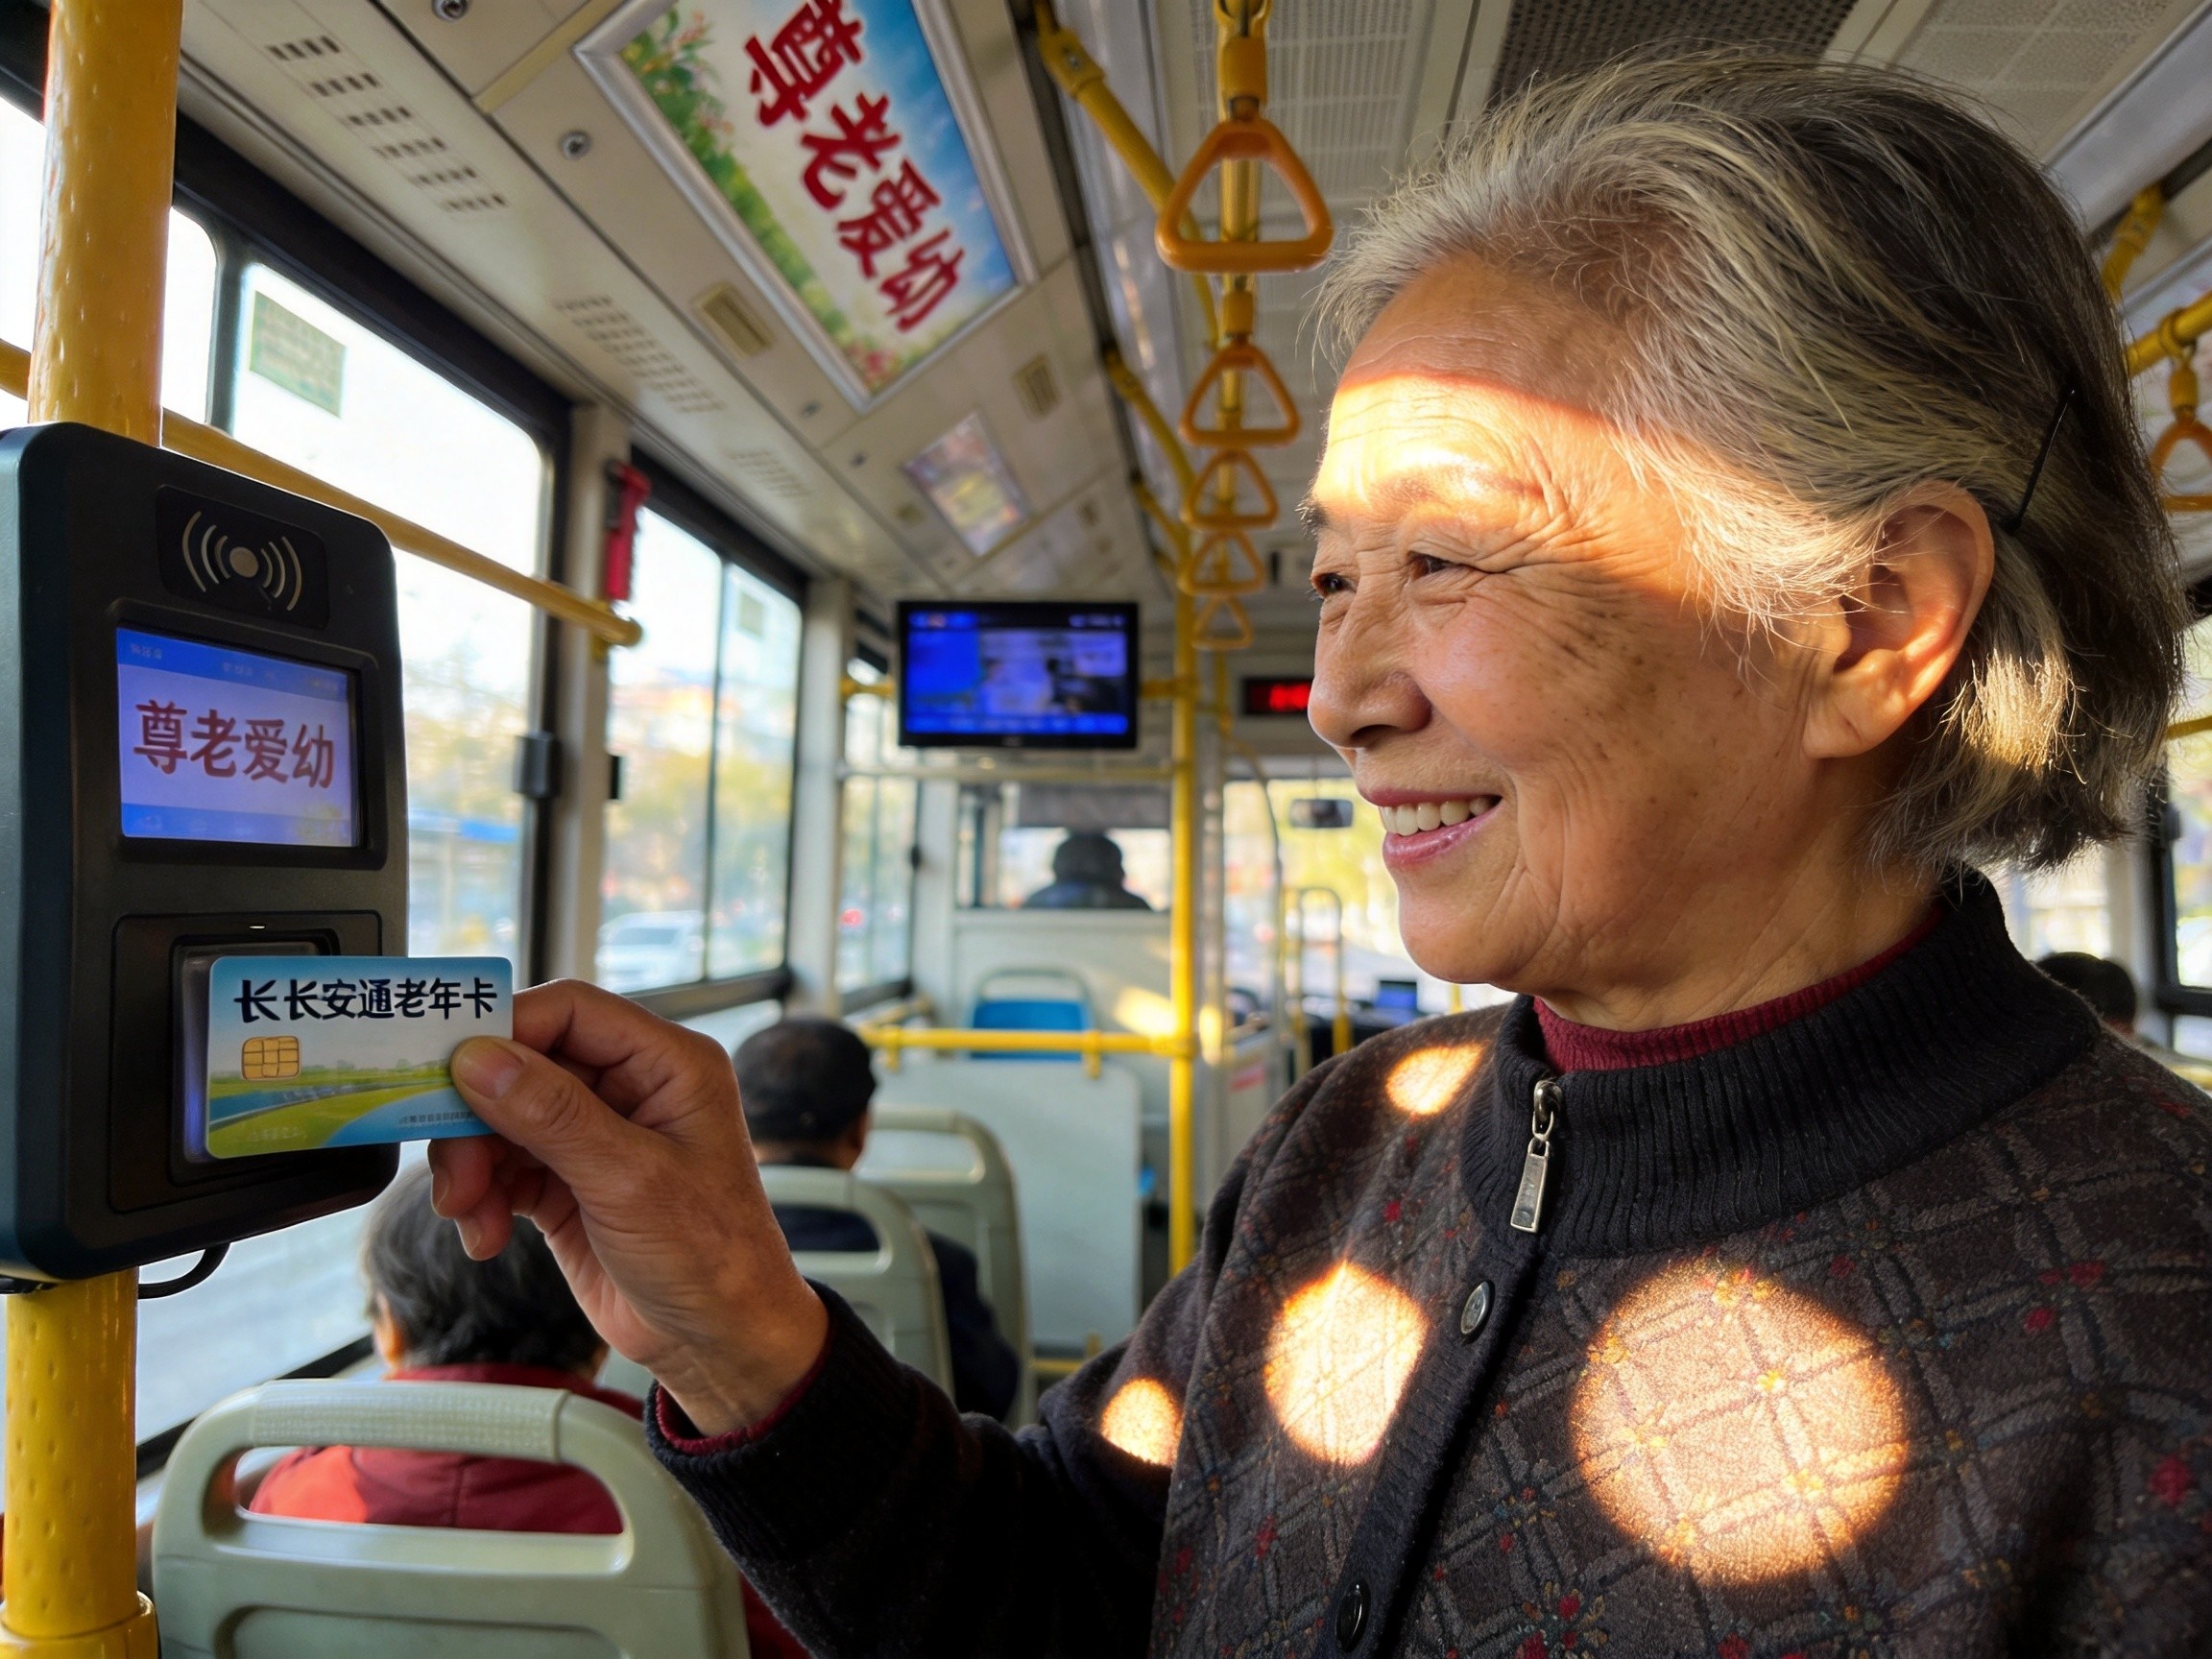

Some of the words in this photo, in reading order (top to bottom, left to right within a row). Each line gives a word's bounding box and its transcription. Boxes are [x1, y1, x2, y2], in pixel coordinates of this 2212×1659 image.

[743, 0, 965, 333] 尊老爱幼
[133, 699, 335, 789] 尊老爱幼
[234, 977, 498, 1023] 长长安通老年卡
